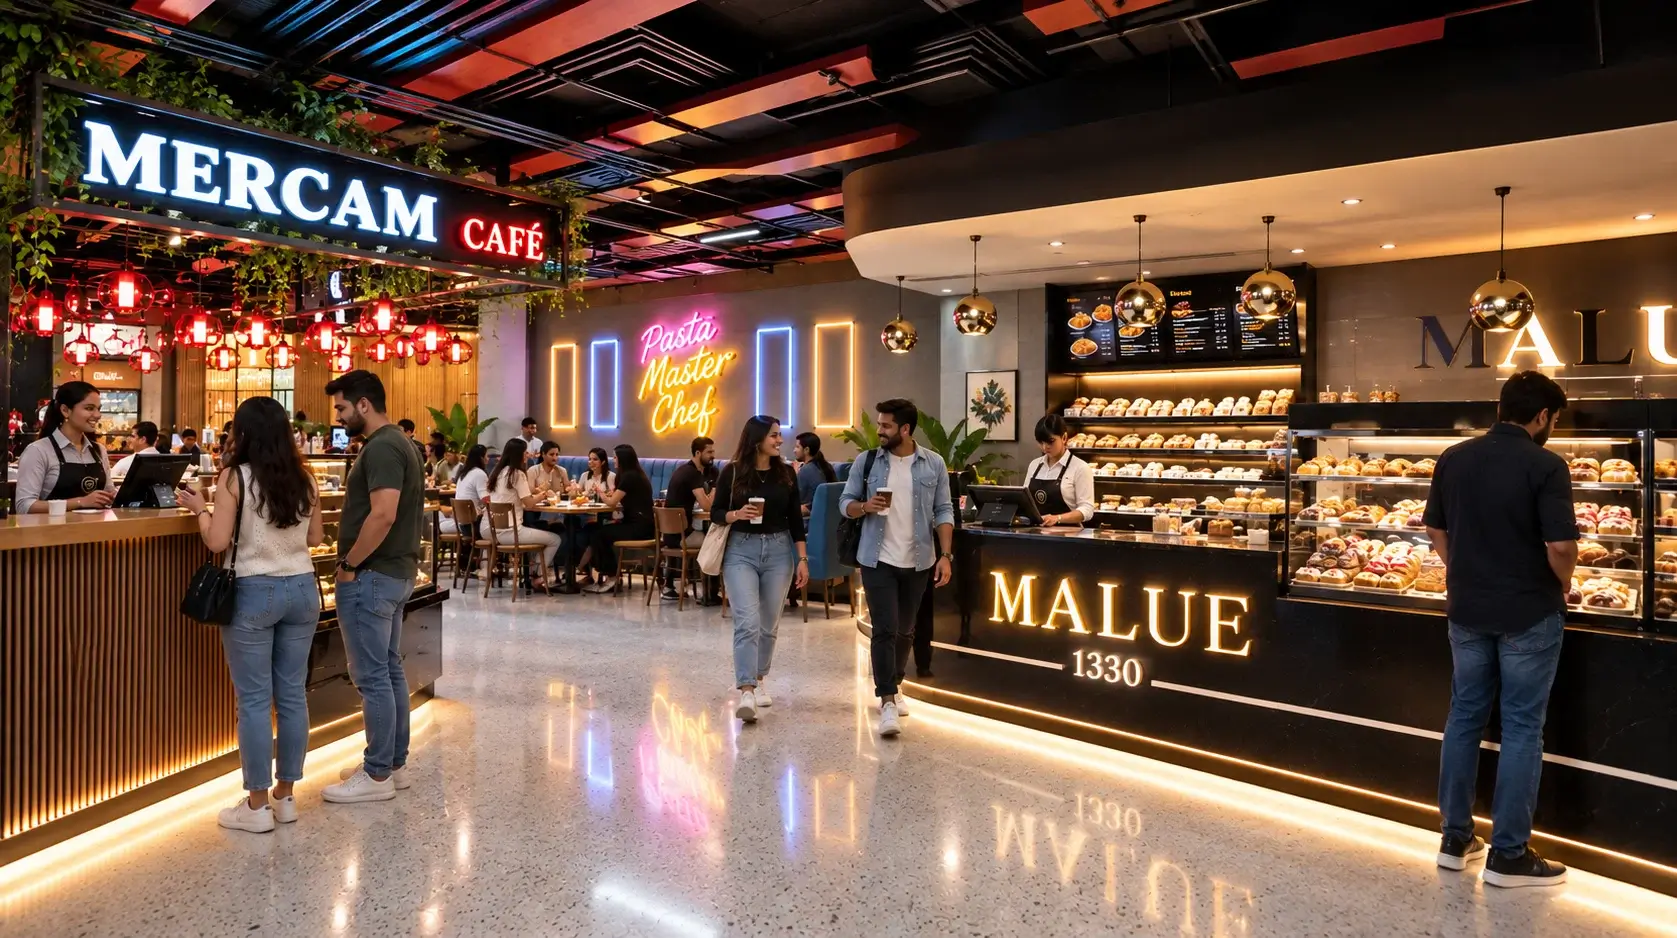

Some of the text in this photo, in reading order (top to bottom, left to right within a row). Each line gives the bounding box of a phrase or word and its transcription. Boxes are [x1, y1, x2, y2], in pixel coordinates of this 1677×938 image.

[83, 120, 545, 262] MERCAM CAFÉ
[641, 311, 718, 364] Pasta
[638, 345, 736, 400] Master
[651, 384, 718, 437] Chef
[989, 571, 1252, 657] MALUE
[1072, 649, 1144, 688] 1330
